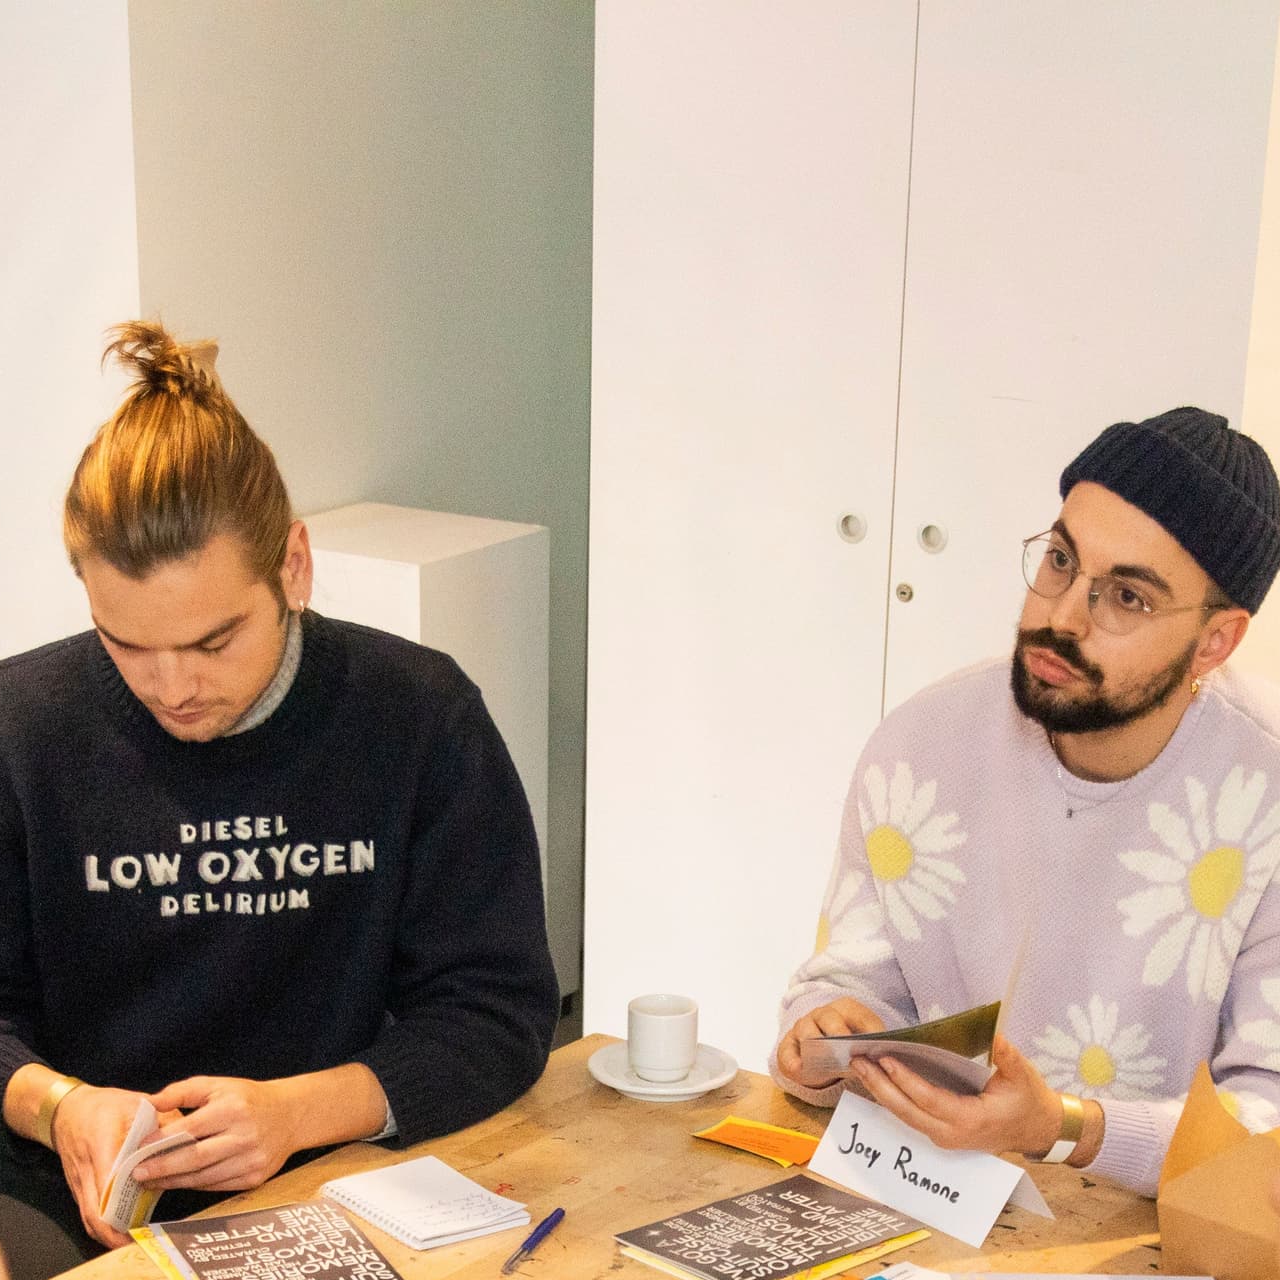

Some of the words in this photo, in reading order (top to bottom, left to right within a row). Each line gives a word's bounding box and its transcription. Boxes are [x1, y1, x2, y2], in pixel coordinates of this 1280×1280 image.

[180, 815, 288, 843] DIESEL
[84, 852, 182, 892] LOW
[197, 839, 374, 884] OXYGEN
[160, 888, 310, 917] DELIRIUM
[838, 1122, 881, 1168] Joey
[894, 1146, 960, 1203] Ramone
[276, 1203, 337, 1219] TIME
[780, 1190, 846, 1215] AFTER
[257, 1218, 351, 1243] BEHIND
[284, 1211, 345, 1229] TIME
[745, 1215, 833, 1246] ALMOST
[800, 1211, 877, 1242] BEHIND
[839, 1213, 889, 1236] TIME
[859, 1207, 906, 1232] TIME
[194, 1222, 275, 1244] AFTER
[297, 1228, 358, 1246] LEFT
[704, 1222, 808, 1266] MEMORIES
[804, 1225, 860, 1248] LEFT
[243, 1237, 347, 1266] ALMOST
[306, 1244, 374, 1264] THAT
[668, 1247, 717, 1264] GOT
[672, 1235, 773, 1277] SUITCASE
[766, 1235, 822, 1260] THAT
[351, 1261, 386, 1275] OF
[753, 1255, 789, 1271] OF
